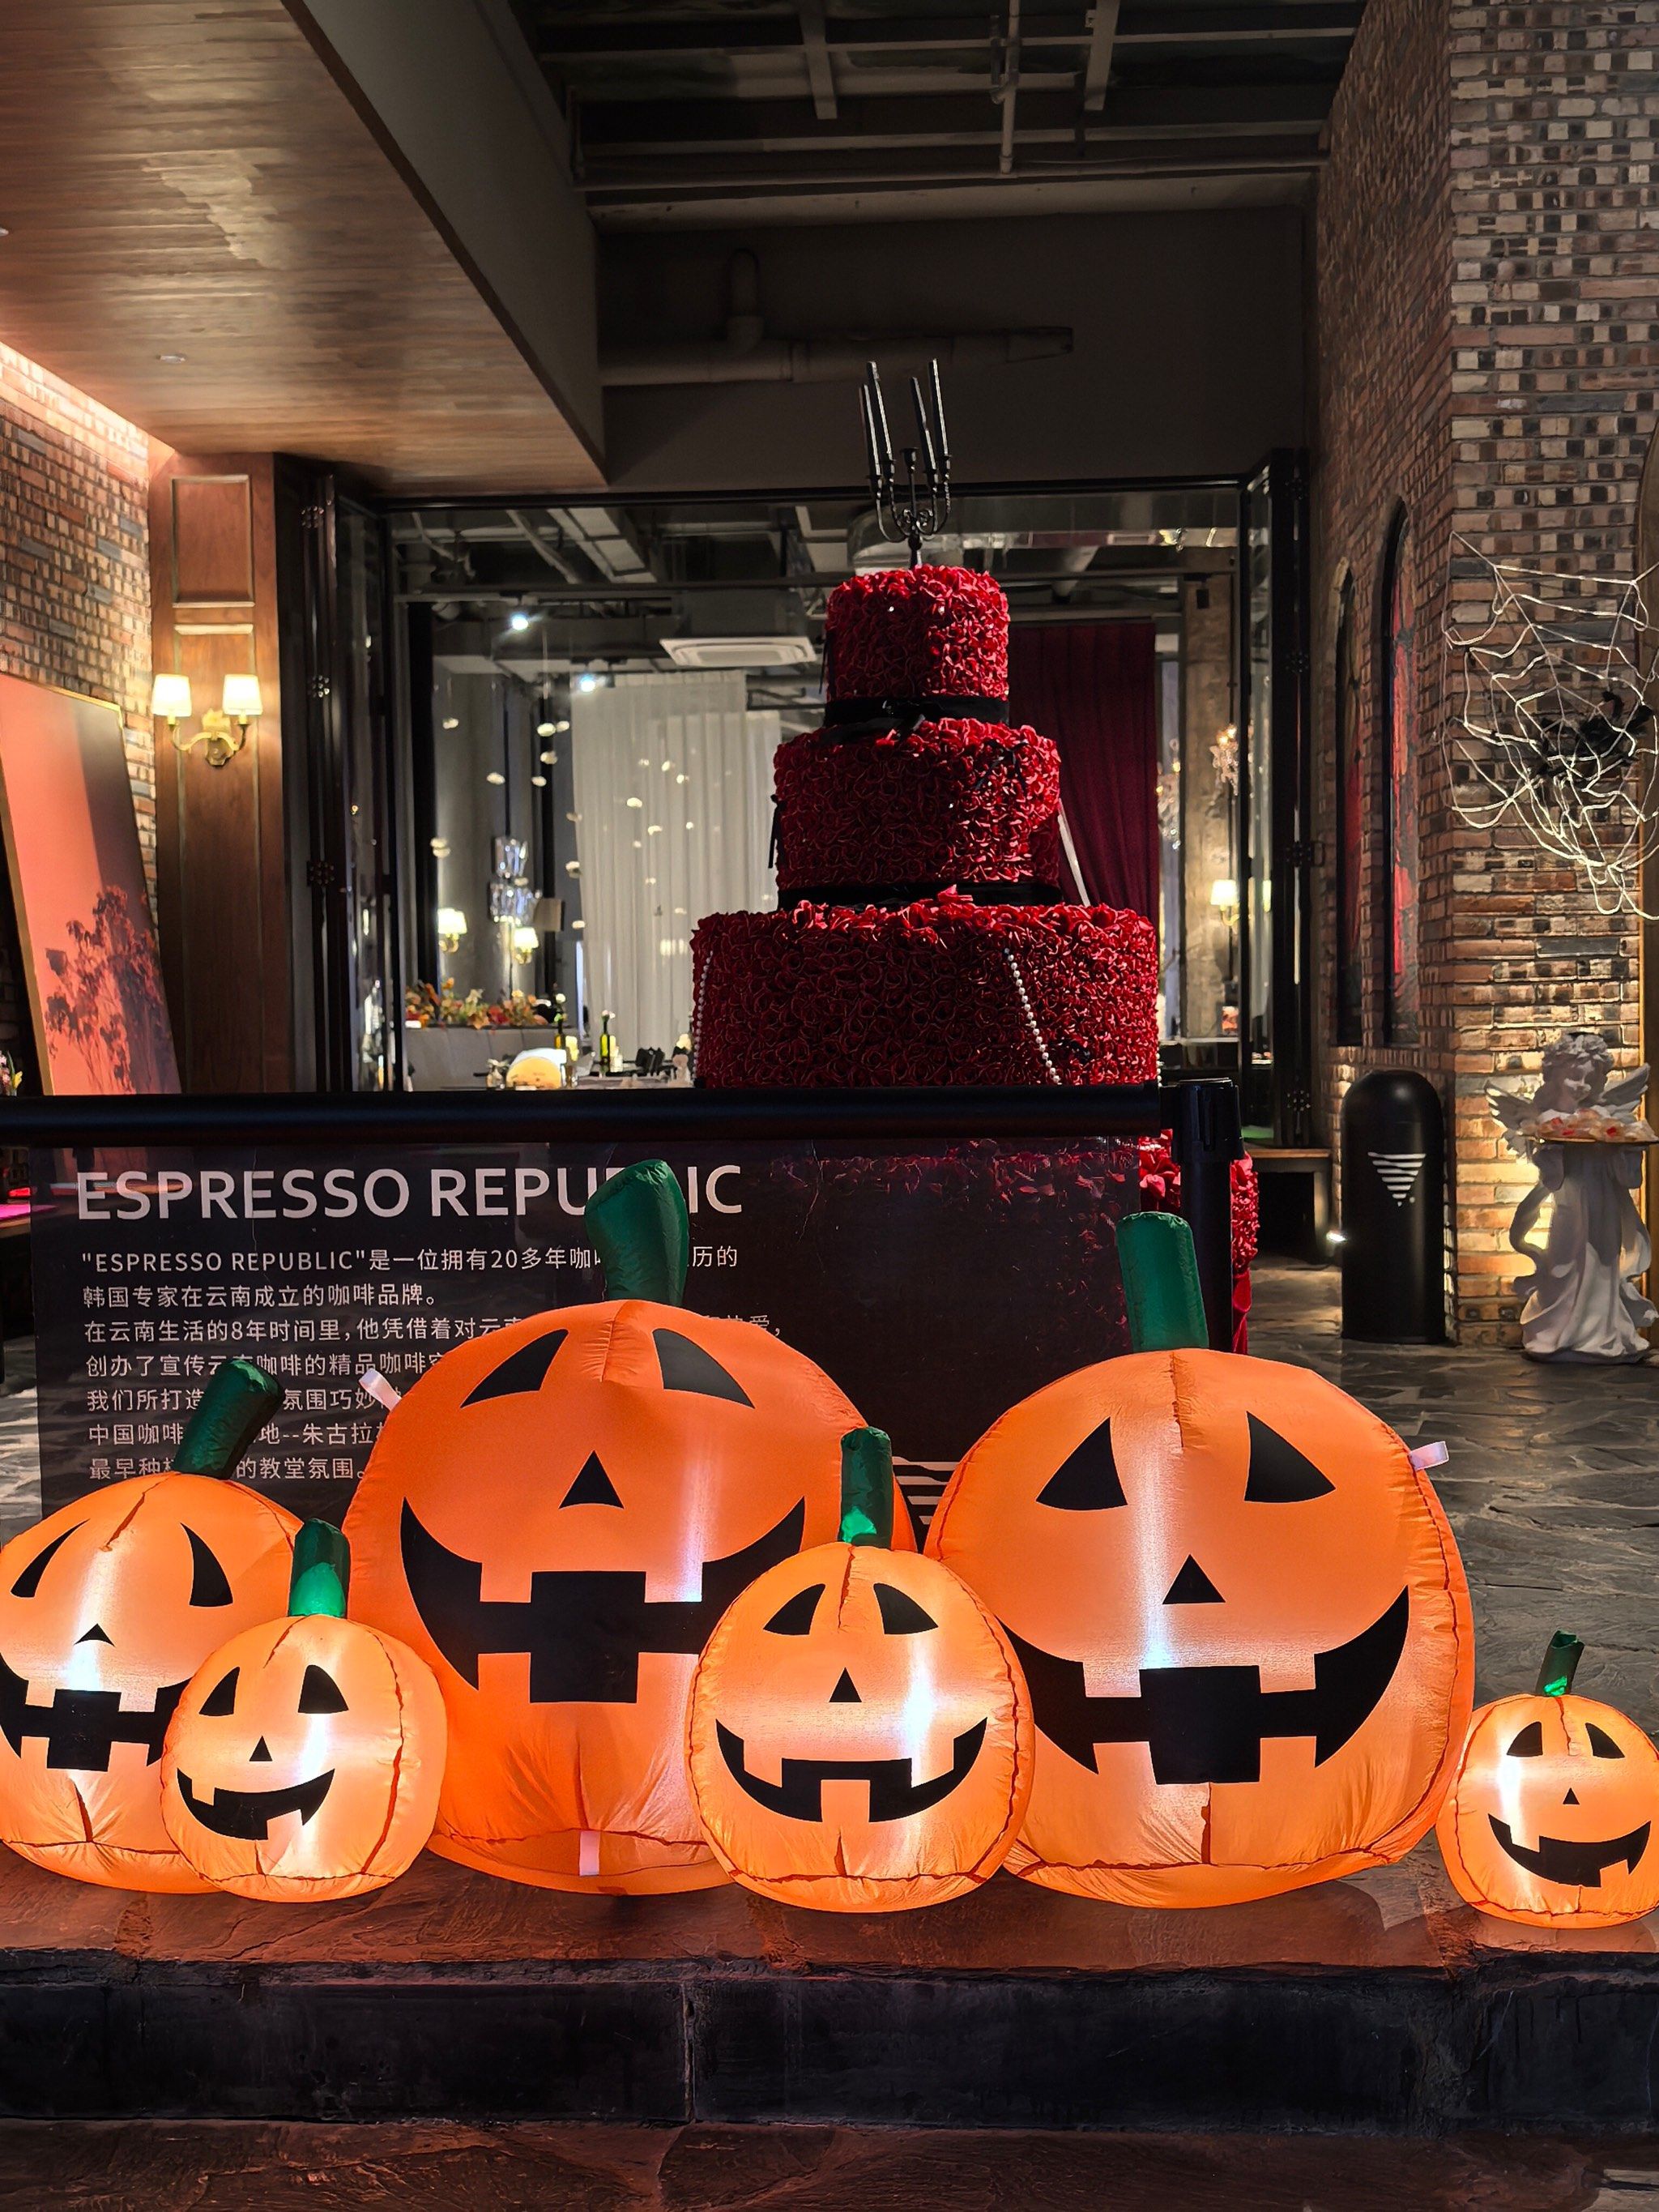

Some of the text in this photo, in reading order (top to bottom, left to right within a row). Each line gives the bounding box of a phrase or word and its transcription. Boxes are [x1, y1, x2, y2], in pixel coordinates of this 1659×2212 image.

[77, 1164, 743, 1219] ESPRESSO REPUIC
[83, 1283, 435, 1309] 韩国专家在云南成立的咖啡品牌。
